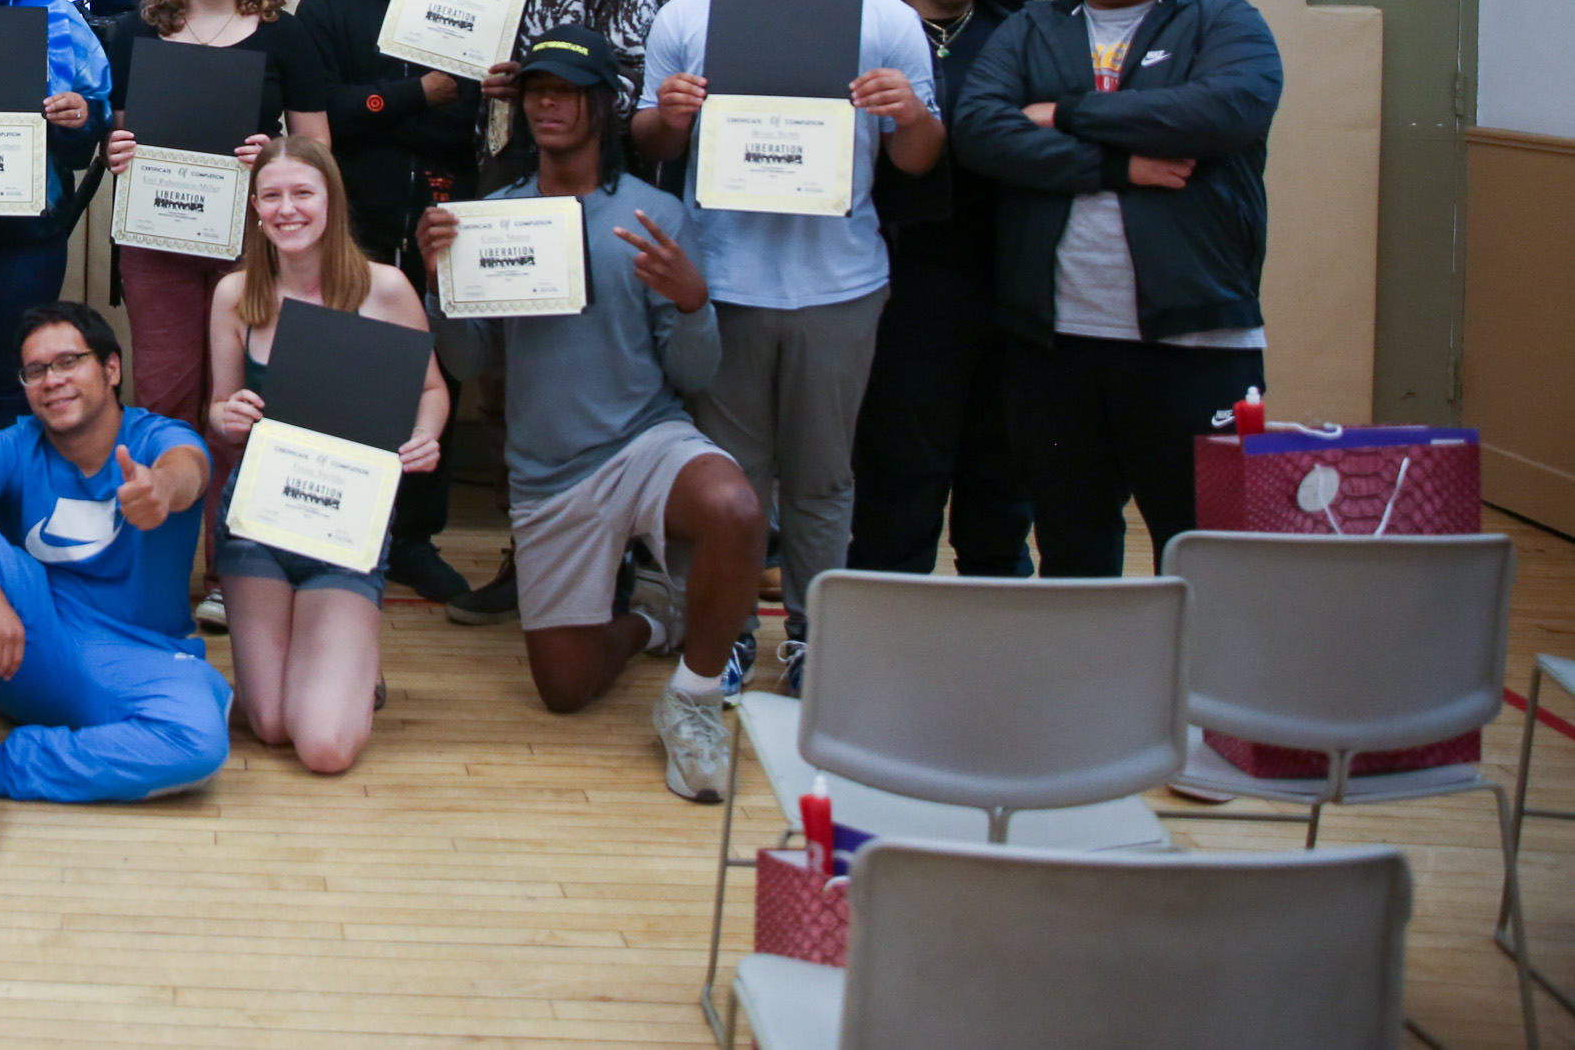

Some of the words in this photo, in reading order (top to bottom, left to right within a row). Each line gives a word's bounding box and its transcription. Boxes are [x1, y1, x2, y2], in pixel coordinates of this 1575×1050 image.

[428, 3, 476, 22] LIBERATION
[745, 143, 803, 154] LIBERATION
[141, 165, 171, 174] CERTIFICATE
[191, 172, 224, 180] COMPLETION
[155, 189, 205, 203] LIBERATION
[479, 246, 535, 257] LIBERATION
[286, 476, 343, 499] LIBERATION
